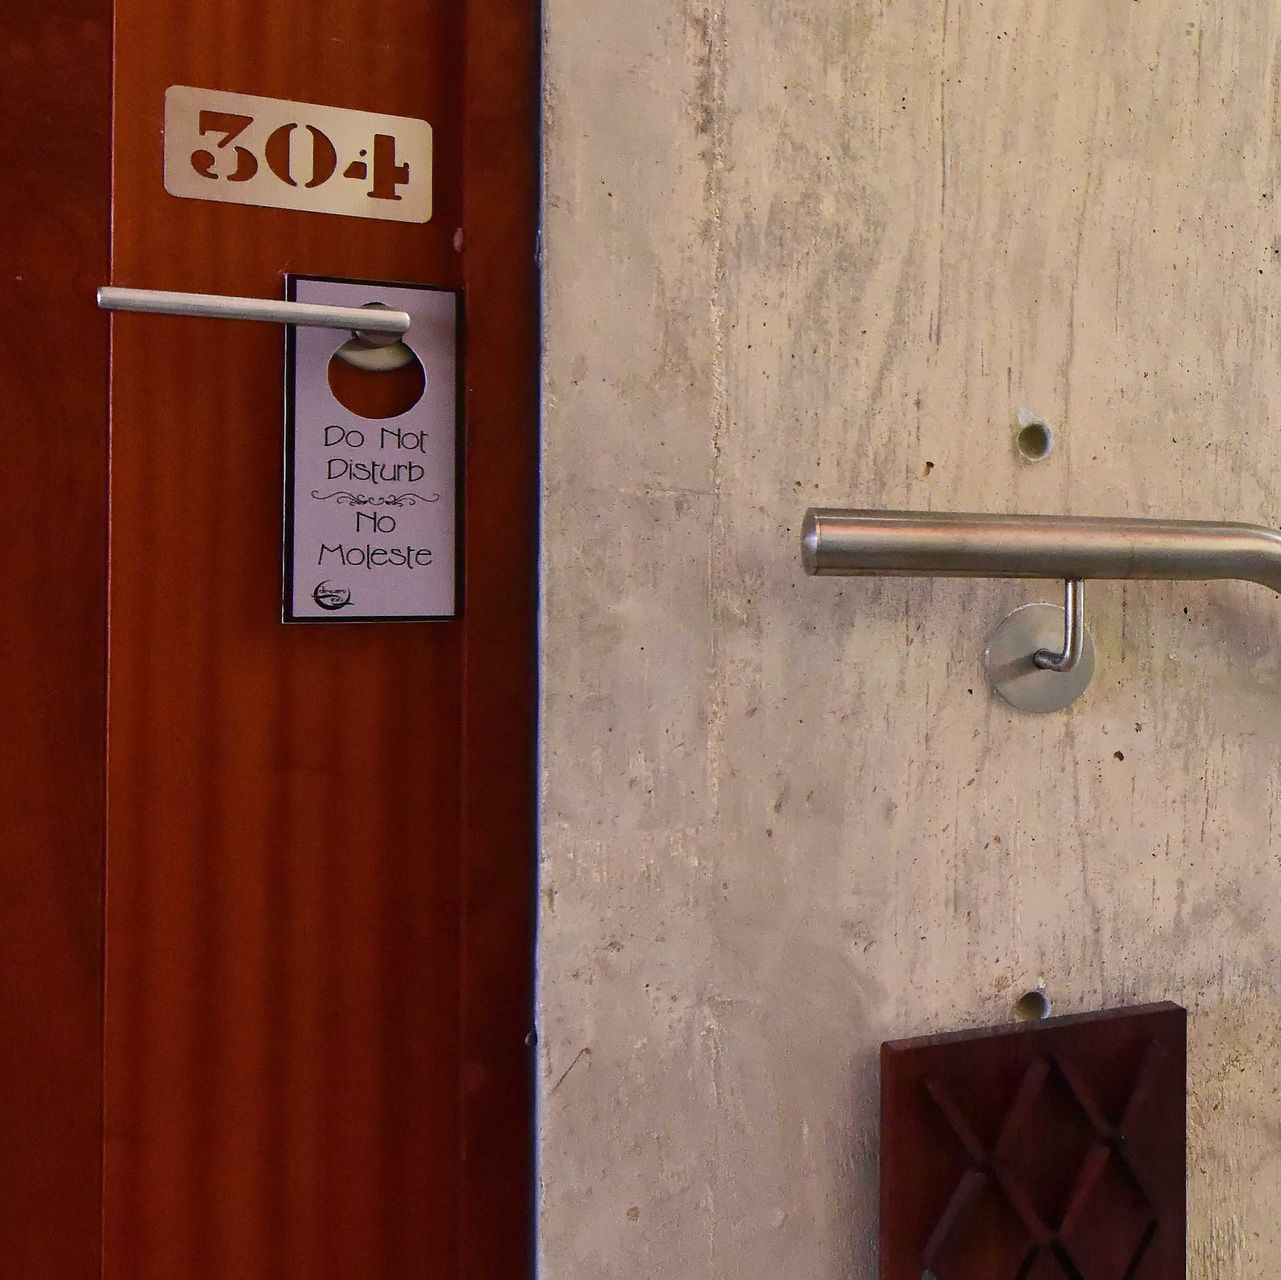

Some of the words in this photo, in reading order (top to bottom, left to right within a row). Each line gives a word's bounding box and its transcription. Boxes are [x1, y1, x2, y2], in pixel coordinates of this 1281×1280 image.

[190, 109, 410, 201] 304
[324, 425, 365, 448] Do
[380, 427, 429, 454] Not
[327, 458, 425, 484] Disturb
[356, 511, 396, 533] No
[318, 543, 433, 570] Moleste
